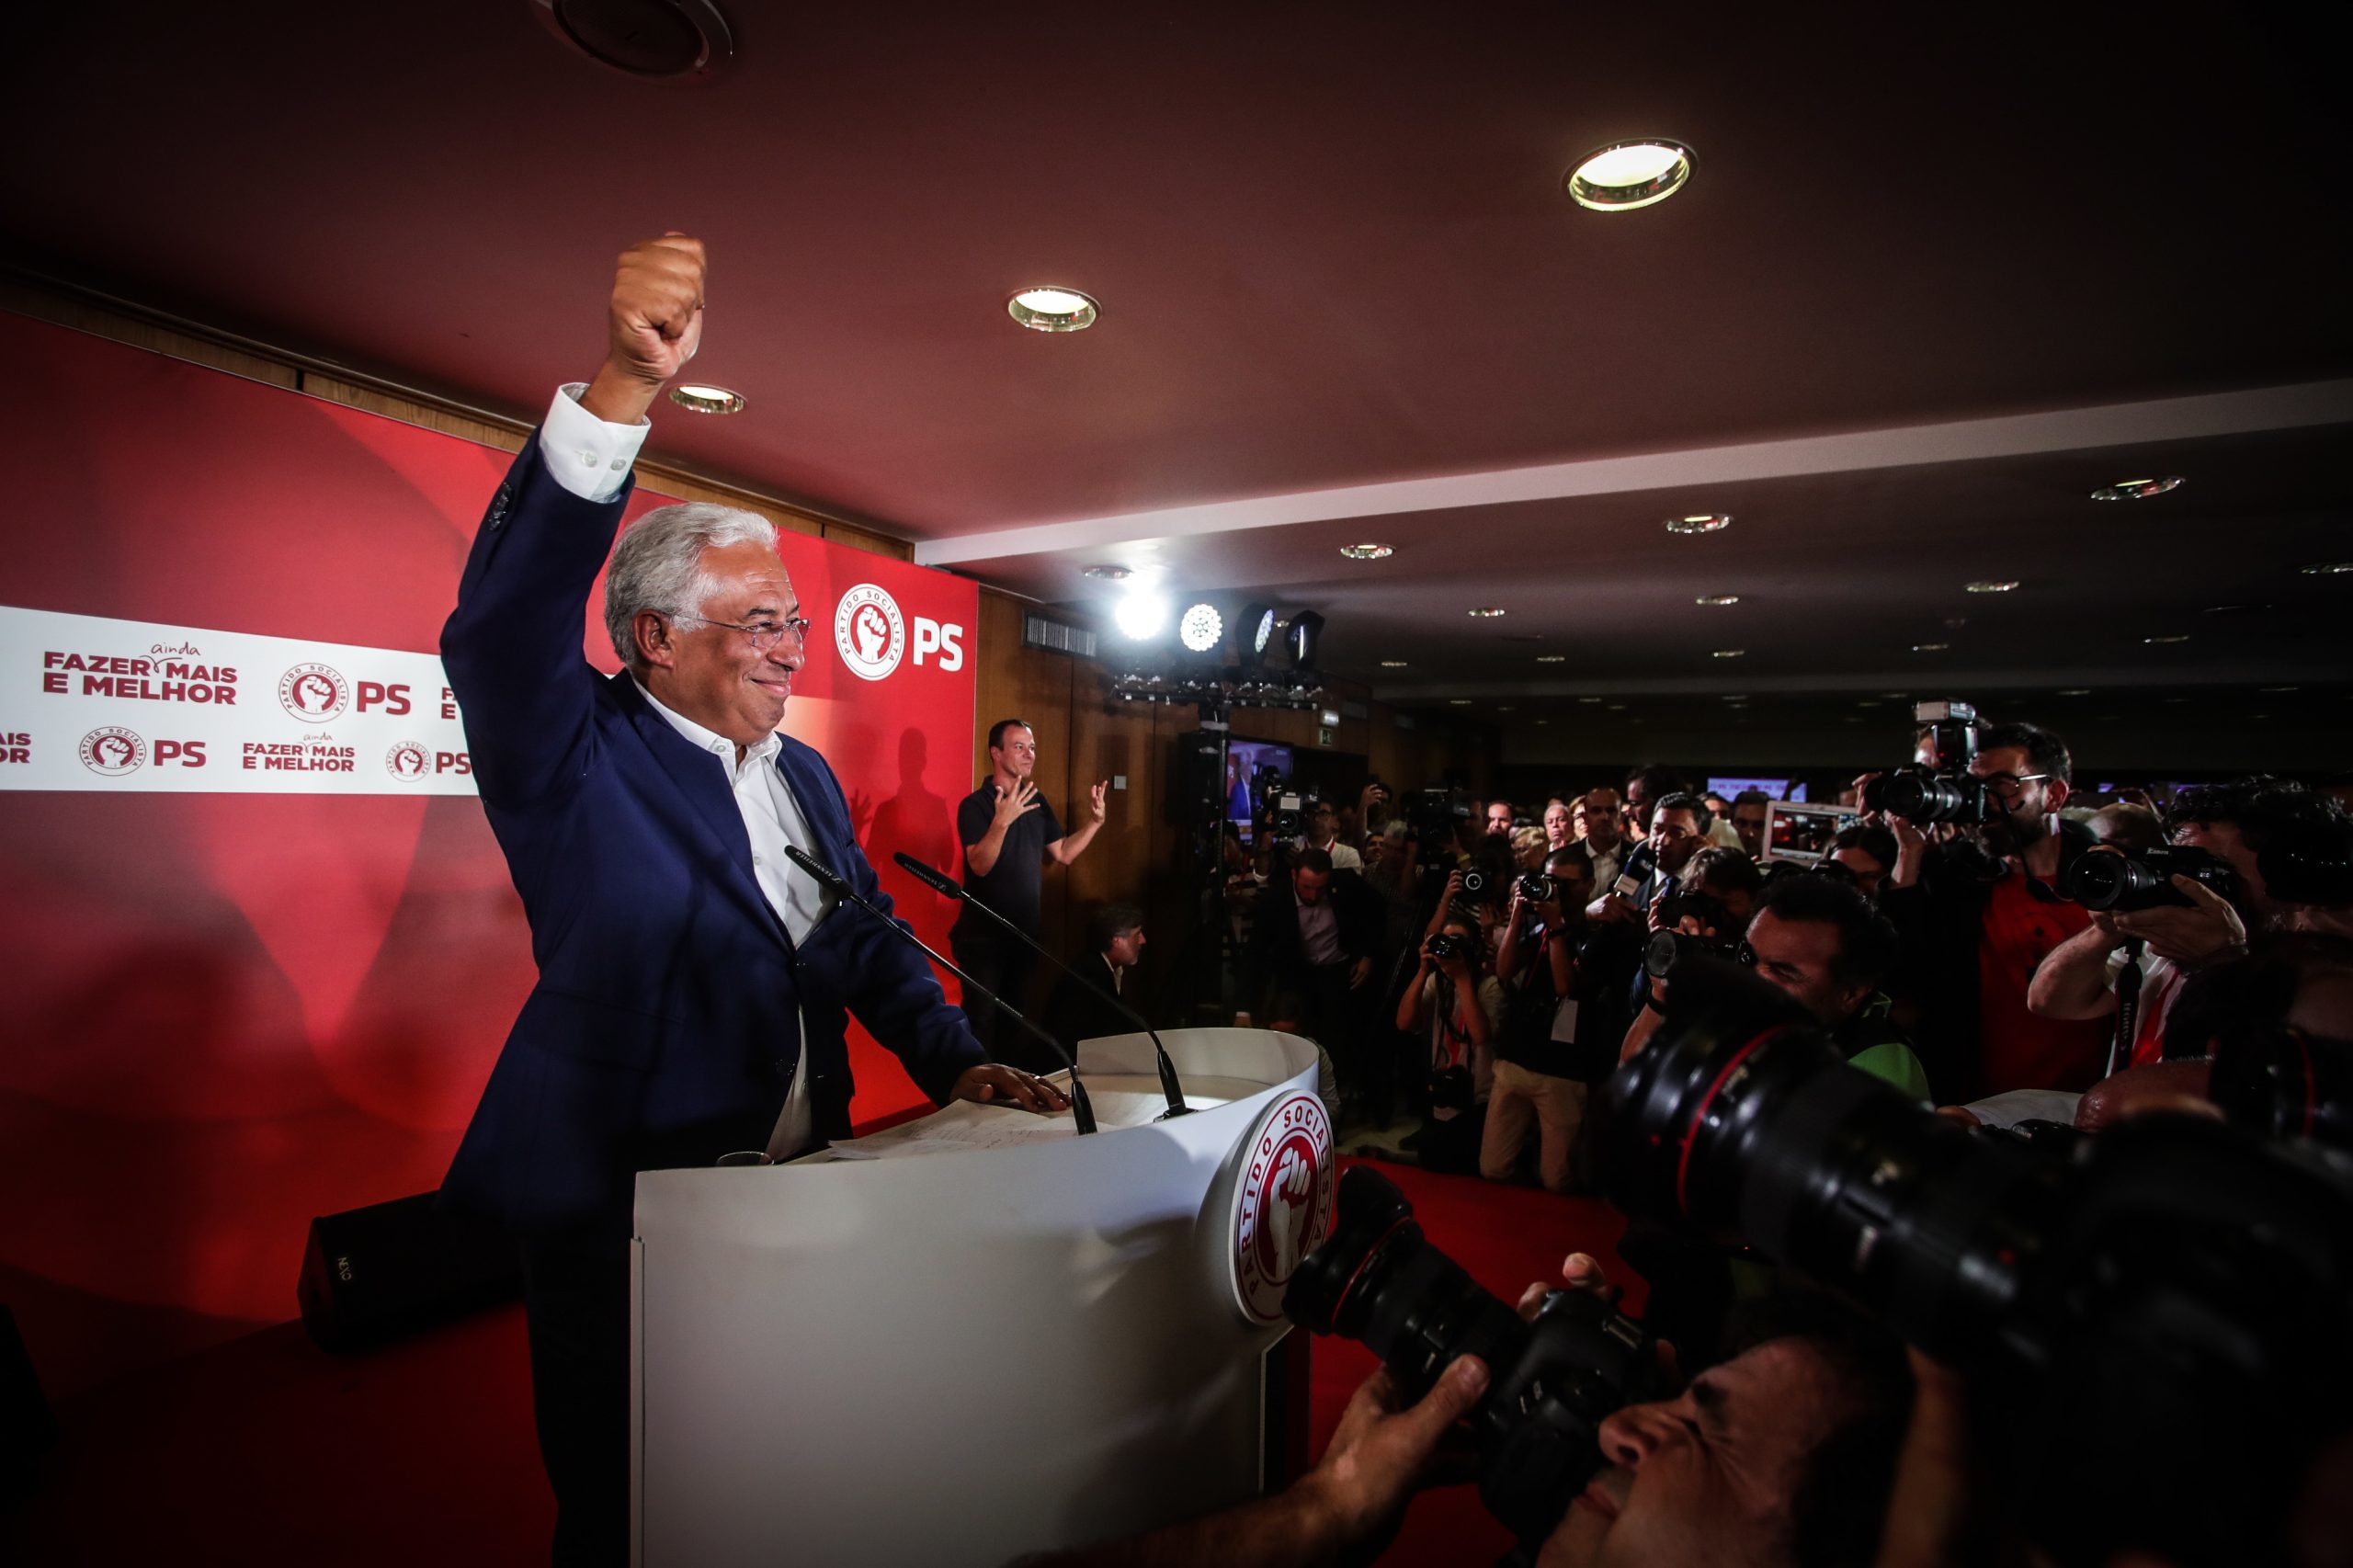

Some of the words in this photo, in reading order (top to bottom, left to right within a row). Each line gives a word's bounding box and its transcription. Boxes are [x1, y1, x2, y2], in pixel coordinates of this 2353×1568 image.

[839, 594, 859, 654] PARTIDO
[867, 590, 901, 662] SOCIALISTA
[151, 642, 201, 656] ainda
[913, 616, 963, 672] PS
[43, 651, 151, 676] FAZER
[165, 662, 238, 684] MAIS
[43, 672, 69, 694] E
[83, 675, 236, 706] MELHOR
[281, 668, 301, 709] PARTIDO
[310, 665, 346, 711] SOCIALISTA
[357, 681, 411, 716] PS
[441, 687, 456, 700] F
[441, 703, 456, 720] E
[82, 732, 101, 766] PARTIDO
[108, 728, 144, 767] SOCIALISTA
[153, 739, 207, 768] PS
[243, 743, 303, 756] FAZER
[313, 745, 355, 758] MAIS
[243, 756, 256, 769] E
[265, 756, 354, 772] MELHOR
[436, 752, 472, 775] PS
[1241, 1136, 1272, 1297] PARTIDO
[1284, 1105, 1329, 1241] SOCIALISTA
